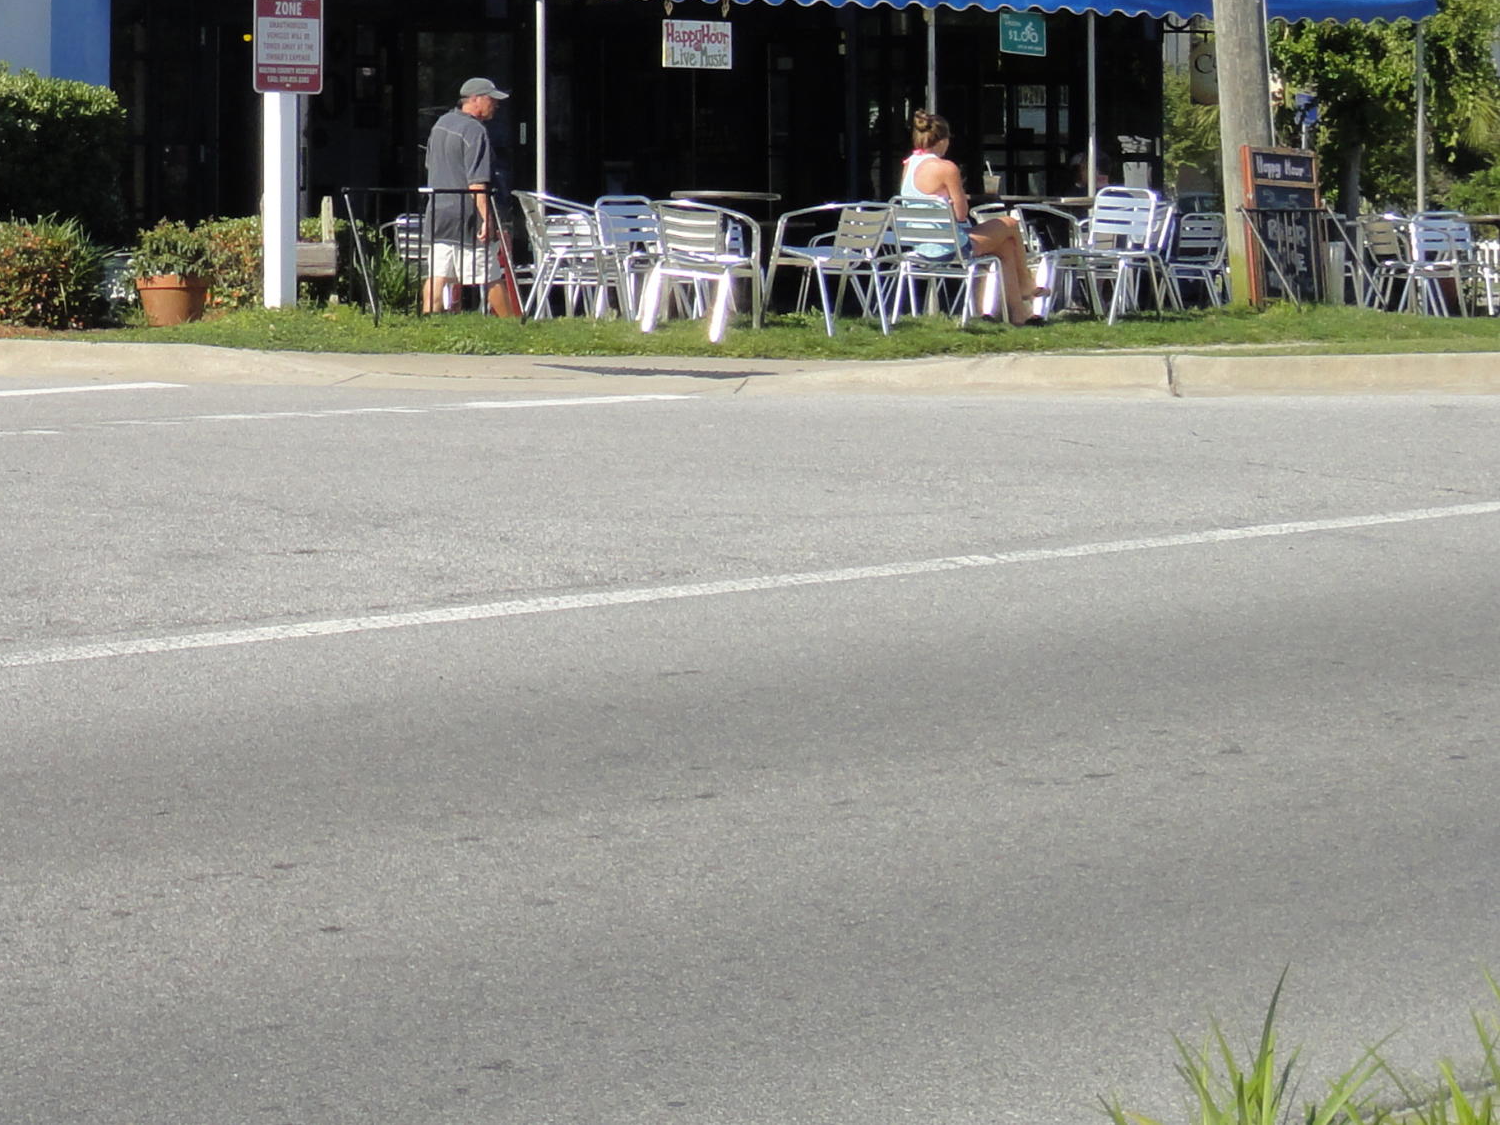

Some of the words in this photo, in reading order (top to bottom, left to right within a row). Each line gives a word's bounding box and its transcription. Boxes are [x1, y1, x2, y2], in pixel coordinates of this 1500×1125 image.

[275, 1, 302, 16] ZONE
[664, 22, 703, 51] Happy
[701, 24, 730, 44] Hour
[671, 46, 697, 66] Live
[700, 47, 729, 67] Music
